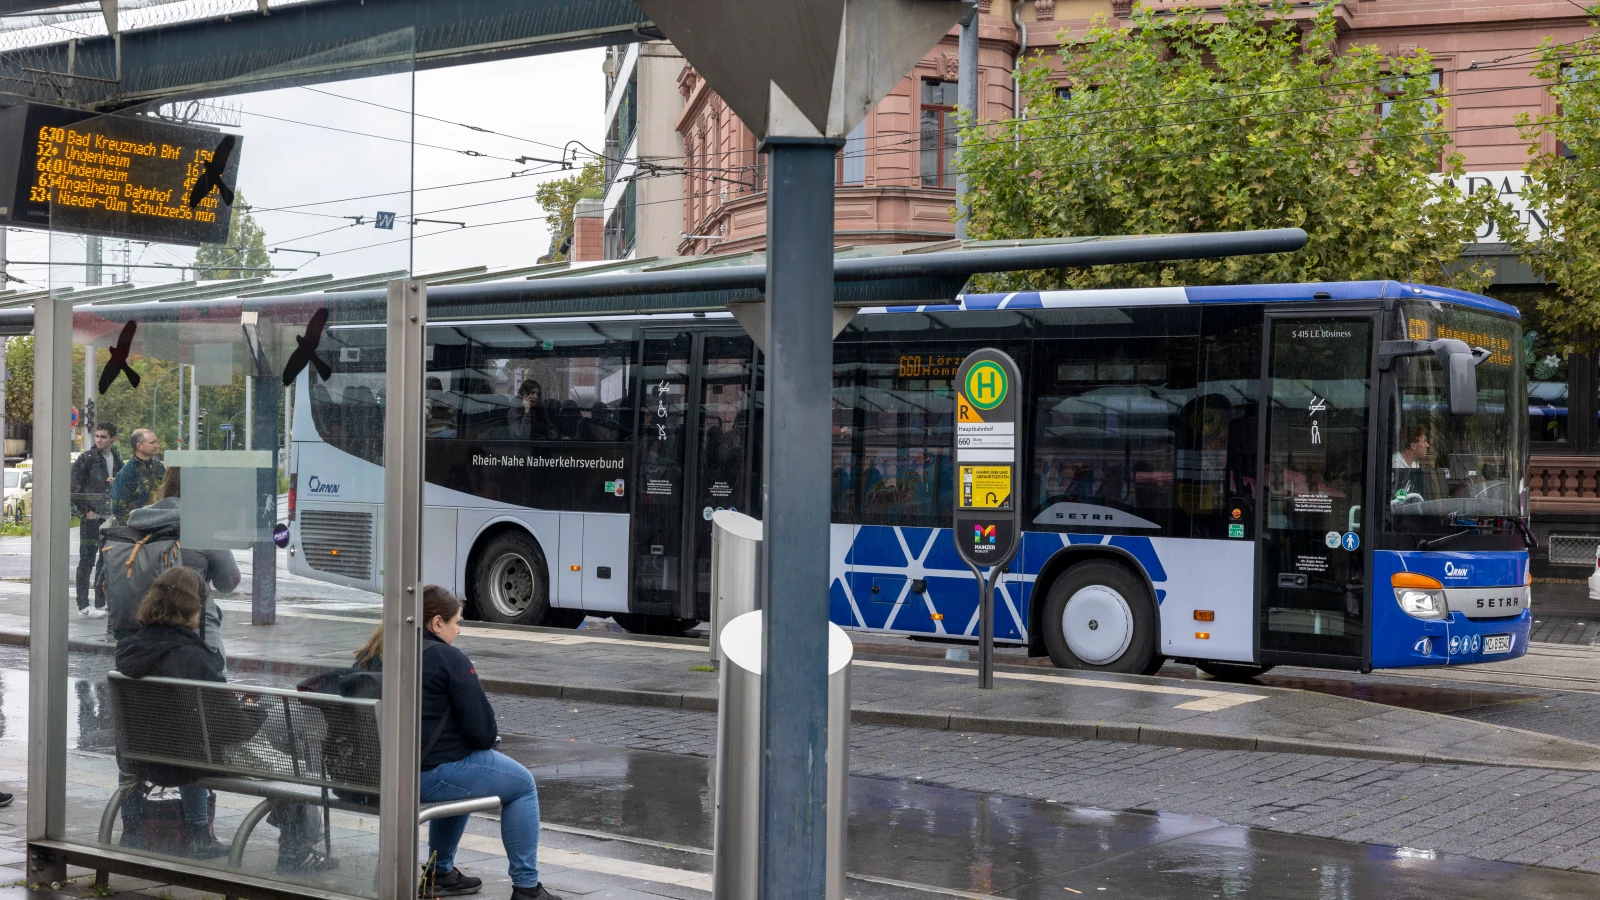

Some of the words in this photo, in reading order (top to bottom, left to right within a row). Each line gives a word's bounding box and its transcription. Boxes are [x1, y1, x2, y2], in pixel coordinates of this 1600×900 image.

[67, 130, 91, 147] Bad
[95, 134, 156, 156] Kreuznach
[161, 144, 182, 160] Bhf
[65, 145, 131, 168] Undenheim
[36, 157, 63, 173] 660
[62, 160, 128, 182] Undenheim
[39, 172, 61, 187] 654
[58, 175, 120, 196] Ingelheim
[124, 183, 173, 202] Bahnhof
[58, 190, 127, 212] Nieder-Olm
[195, 208, 216, 223] min
[1291, 330, 1297, 338] S
[1297, 330, 1309, 338] 415
[1310, 330, 1320, 338] LE
[1321, 329, 1352, 338] business
[899, 355, 921, 377] 660
[1485, 349, 1513, 366] eiler
[977, 372, 996, 399] H
[960, 405, 970, 420] R
[958, 437, 971, 446] 660
[472, 454, 525, 467] Rhein-Nahe
[526, 455, 624, 469] Nahverkehrsverbund
[1055, 512, 1114, 521] SETRA
[1476, 597, 1519, 608] SETRA
